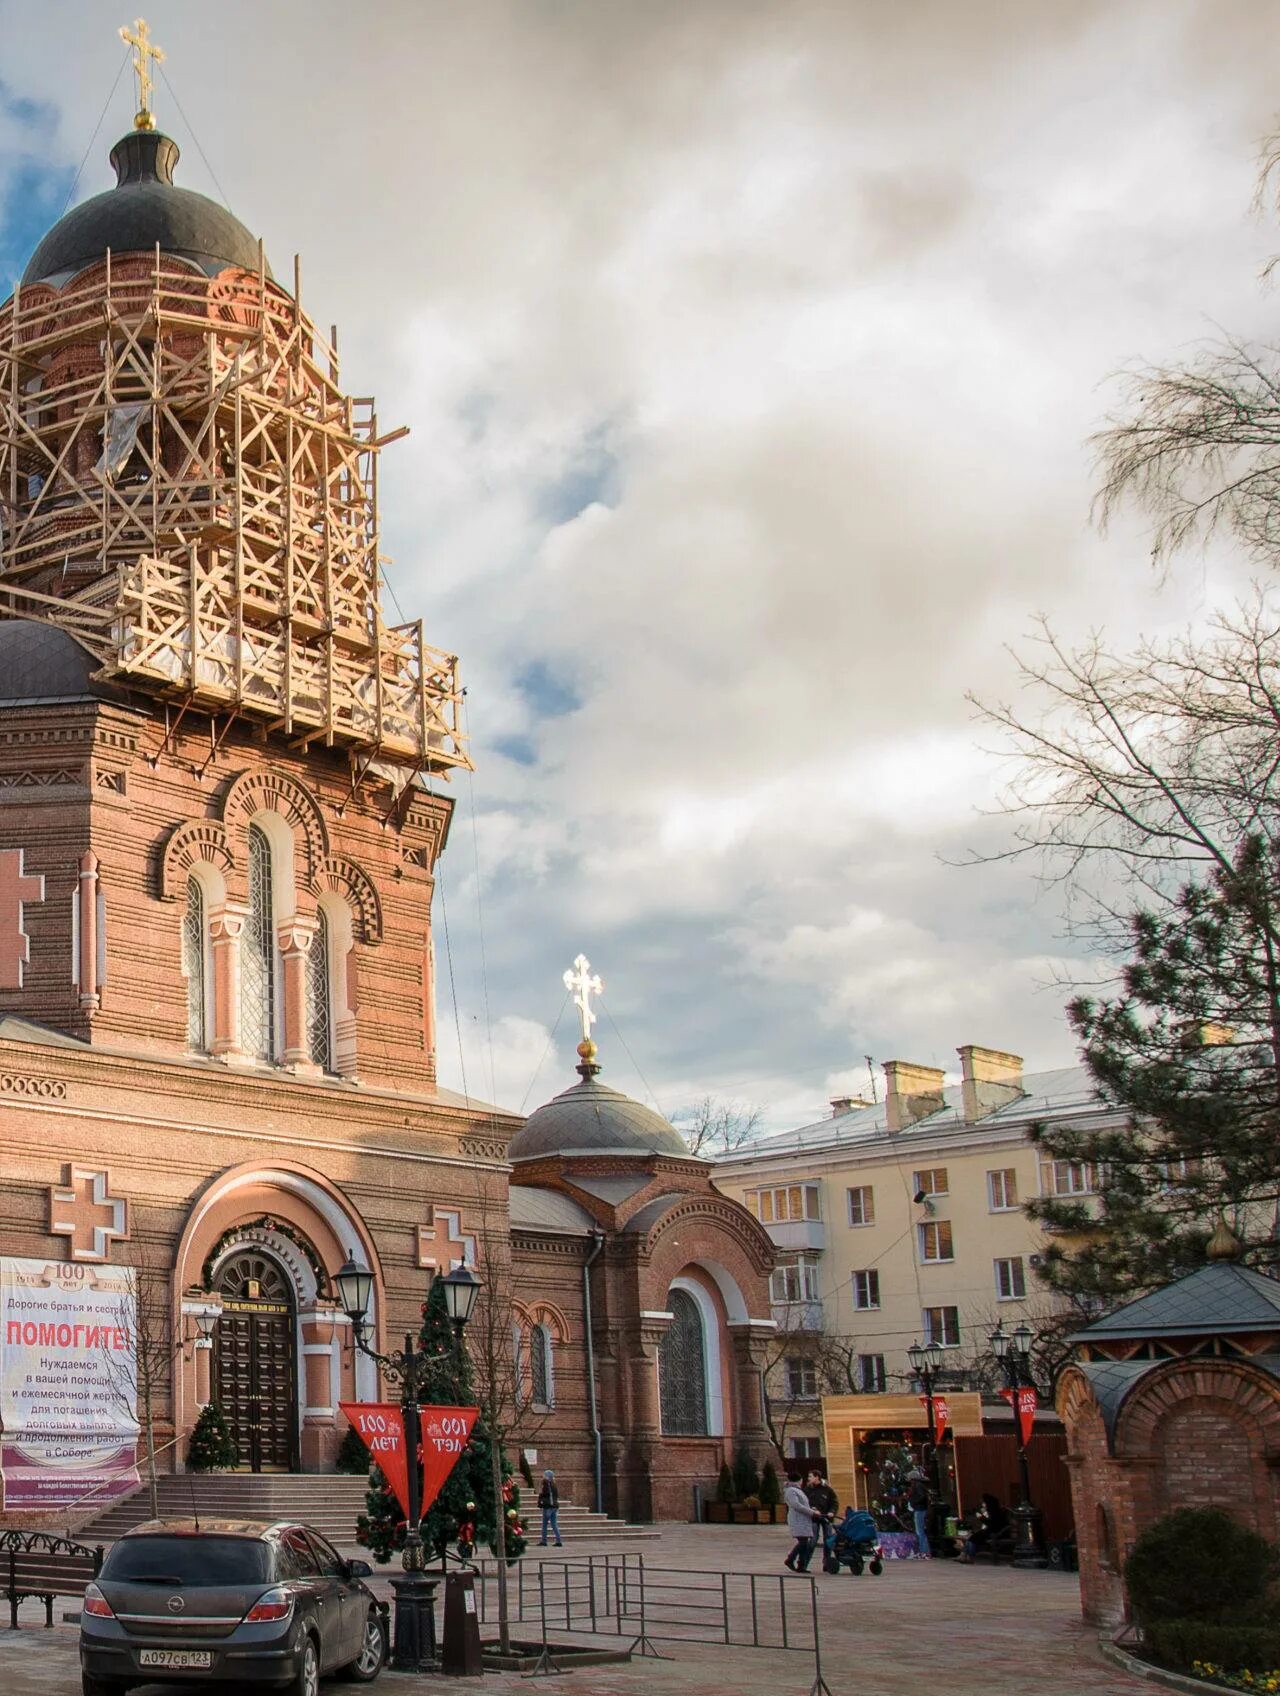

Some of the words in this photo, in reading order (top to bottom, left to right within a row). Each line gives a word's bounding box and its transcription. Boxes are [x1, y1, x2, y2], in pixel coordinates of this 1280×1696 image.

[56, 1263, 85, 1280] 100
[7, 1298, 48, 1312] Дорогие
[50, 1300, 84, 1313] братья
[87, 1304, 93, 1312] и
[6, 1321, 130, 1350] ПОМОГИТЕ!
[40, 1357, 98, 1371] Нуждаемся
[26, 1374, 32, 1383] в
[35, 1374, 68, 1384] вашей
[71, 1377, 111, 1386] помощи
[12, 1390, 18, 1398] и
[21, 1390, 90, 1400] ежемесячной
[31, 1405, 51, 1415] для
[53, 1407, 108, 1416] погашения
[26, 1421, 77, 1430] долговых
[357, 1414, 386, 1433] 100
[16, 1433, 22, 1441] и
[24, 1432, 94, 1443] продолжения
[96, 1434, 126, 1445] работ
[370, 1436, 398, 1451] ЛЕТ
[45, 1449, 52, 1458] в
[55, 1447, 96, 1460] Соборе.
[190, 1652, 208, 1662] 123
